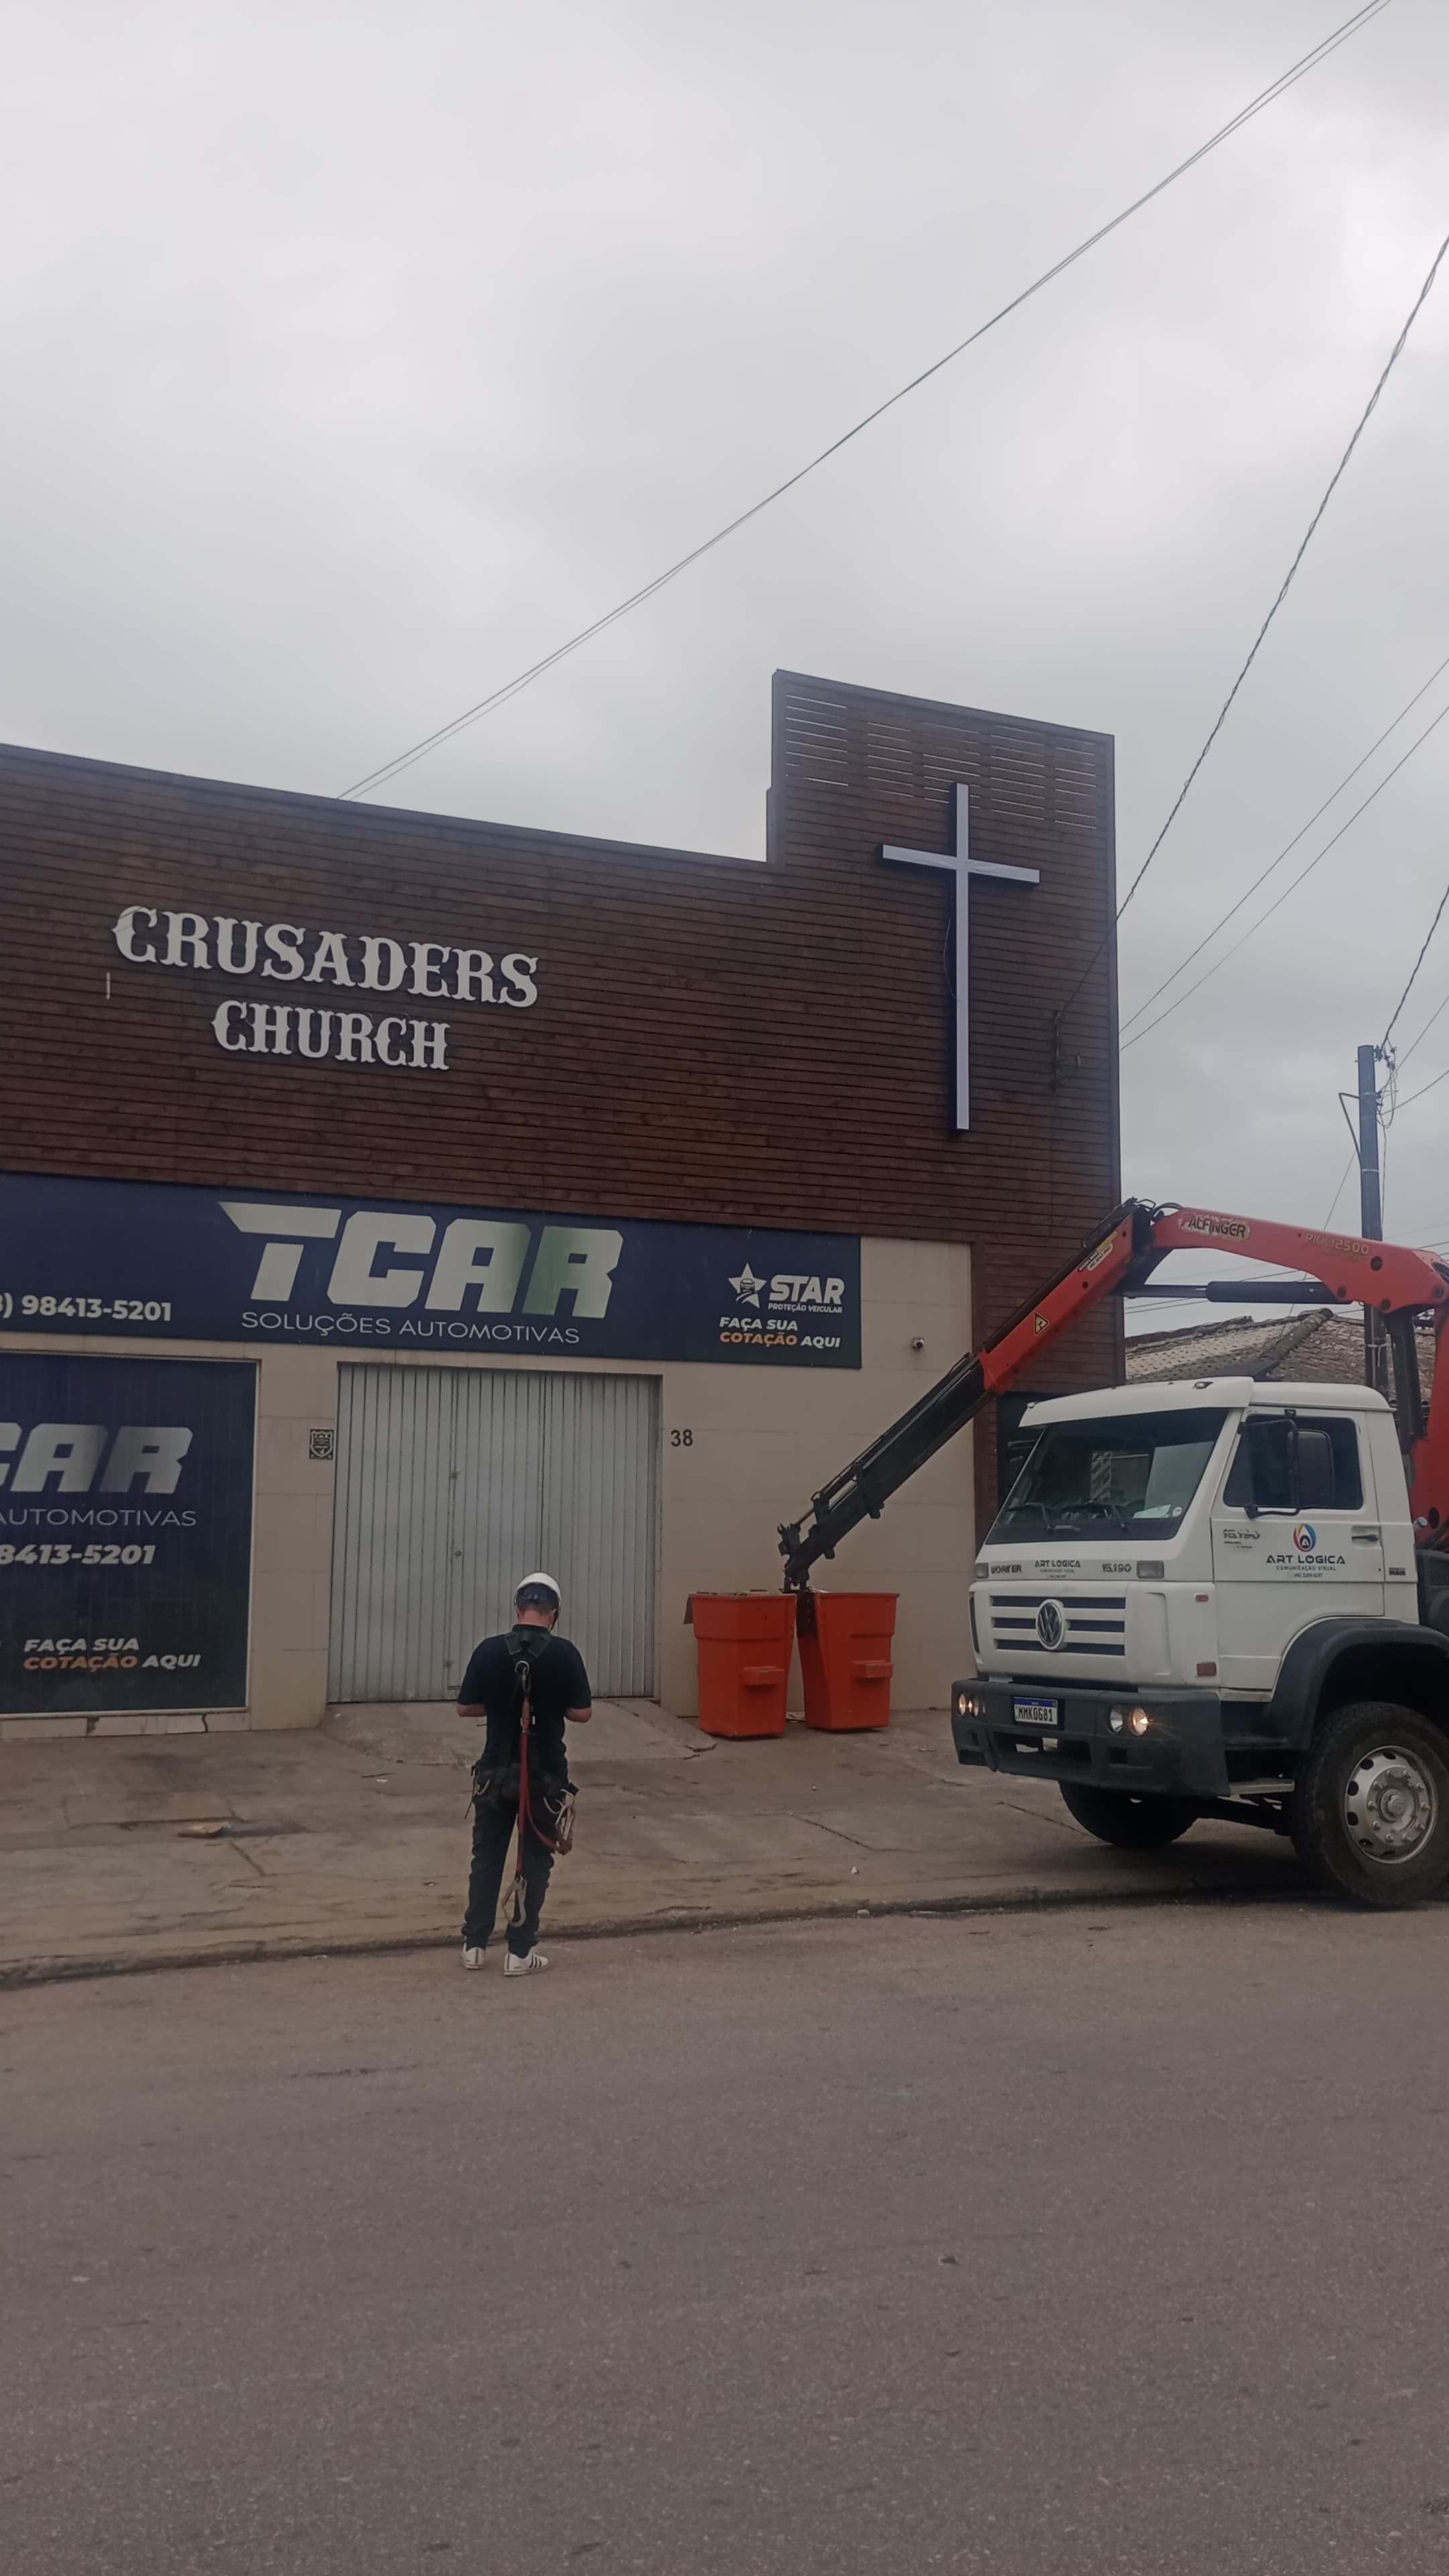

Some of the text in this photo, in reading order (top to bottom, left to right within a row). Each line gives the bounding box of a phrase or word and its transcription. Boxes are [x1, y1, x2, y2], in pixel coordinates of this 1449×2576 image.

[110, 905, 539, 1008] CRUSADERS
[210, 1000, 451, 1071] CHURCH
[218, 1201, 623, 1318] TCAR
[769, 1274, 845, 1305] STAR
[21, 1295, 172, 1321] 98413-5201
[767, 1303, 843, 1313] PROTEÇÃO VEICULAR
[241, 1311, 580, 1344] SOLUÇÕES AUTOMOTIVAS
[718, 1317, 798, 1331] FAÇA SUA
[719, 1331, 841, 1349] COTAÇÃO AQUI
[670, 1429, 694, 1447] 38
[0, 1422, 194, 1494] AR
[1034, 1560, 1081, 1568] ART LOGICA
[1266, 1554, 1346, 1564] ART LOGICA
[23, 1638, 140, 1655] FAÇA SUA
[23, 1652, 201, 1672] COTAÇÃO AQUI
